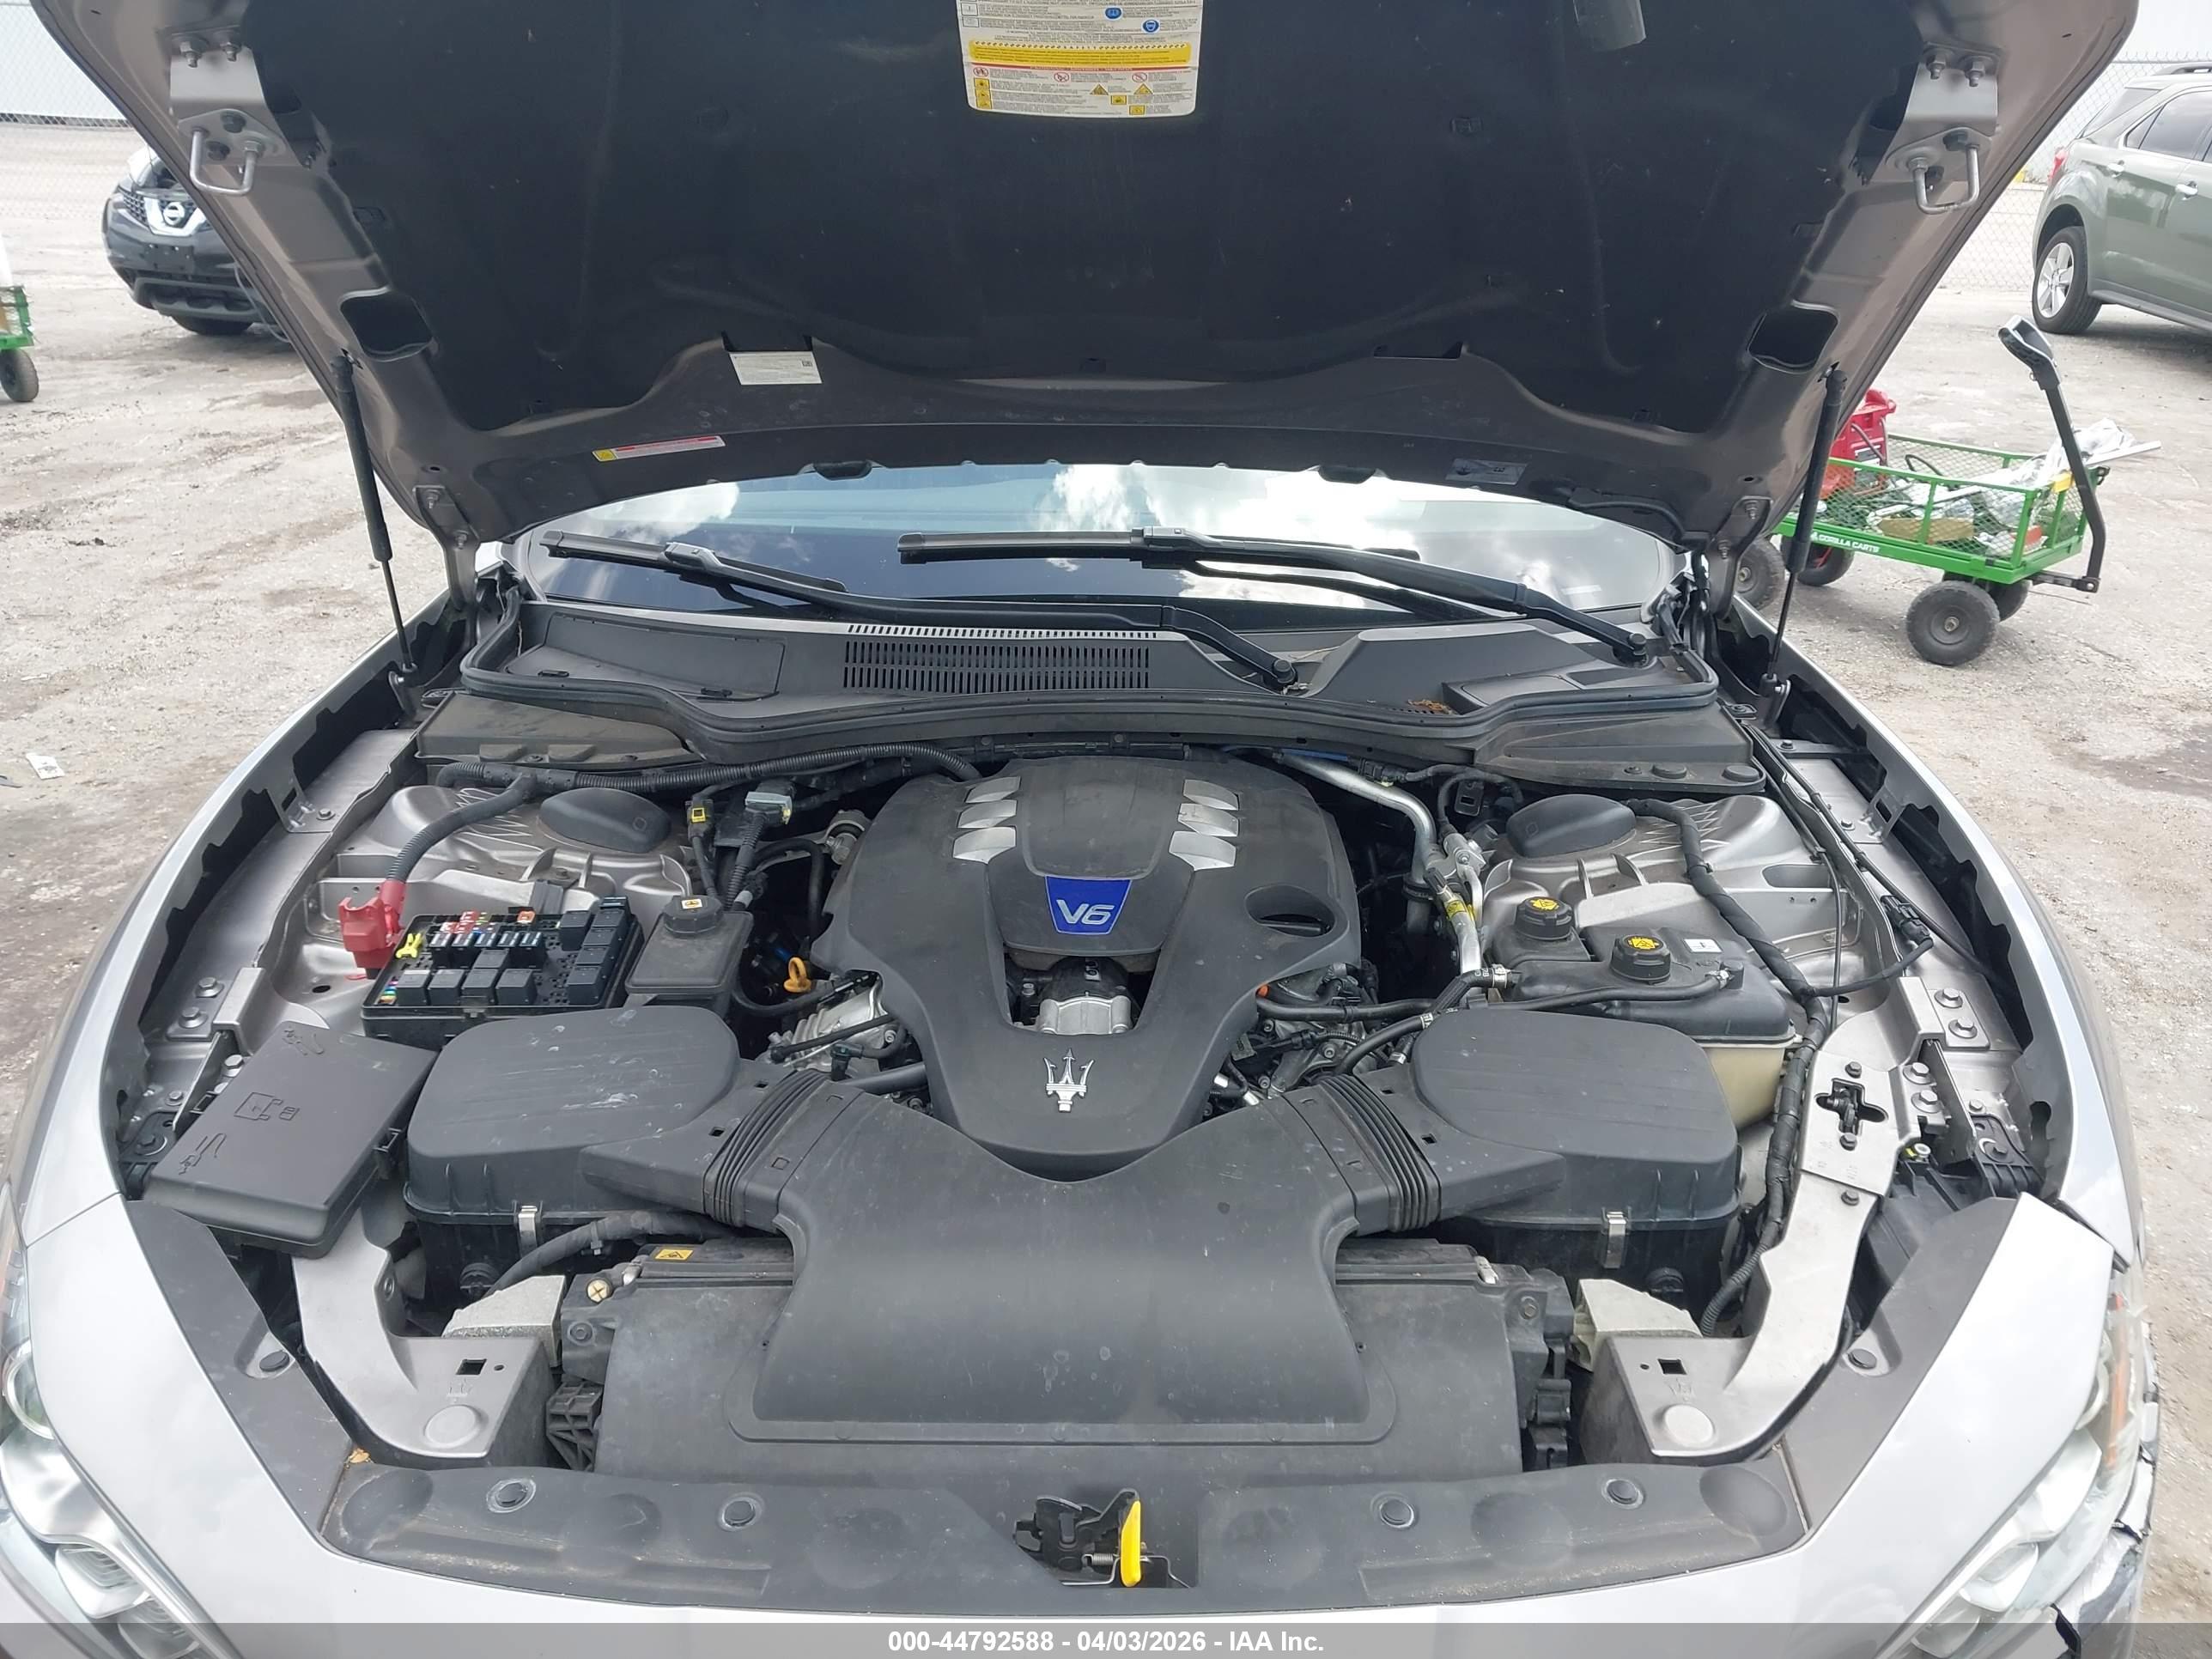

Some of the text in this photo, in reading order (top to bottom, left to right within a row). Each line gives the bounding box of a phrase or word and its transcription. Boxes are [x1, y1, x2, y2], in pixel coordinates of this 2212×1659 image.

[1818, 533, 1881, 553] GORILLA CARTS
[1055, 899, 1115, 925] V6
